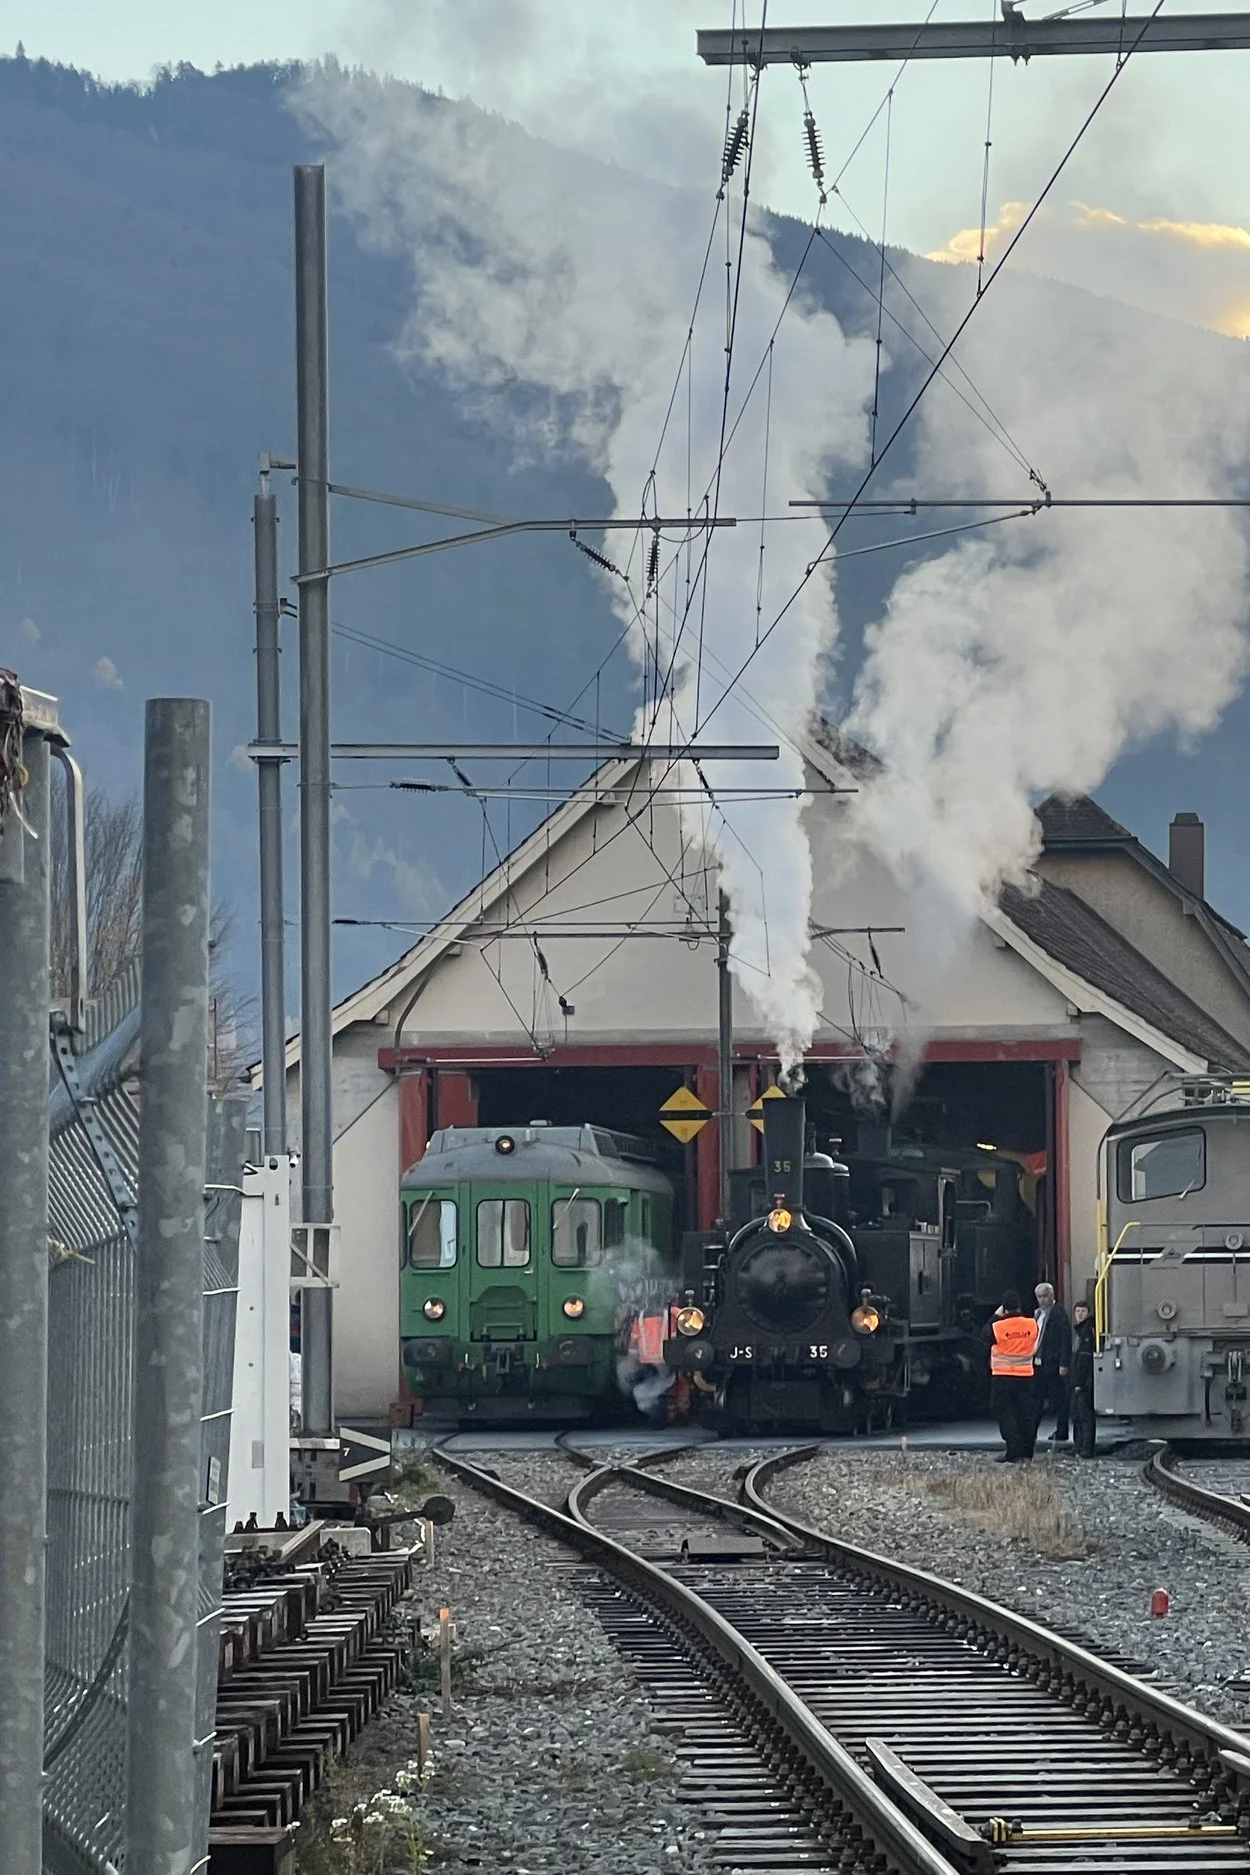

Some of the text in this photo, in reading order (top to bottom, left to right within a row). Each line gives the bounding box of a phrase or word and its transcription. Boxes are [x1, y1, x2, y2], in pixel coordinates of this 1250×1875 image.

[774, 1160, 792, 1173] 35
[729, 1345, 828, 1359] J-S 35
[343, 1447, 351, 1457] 7
